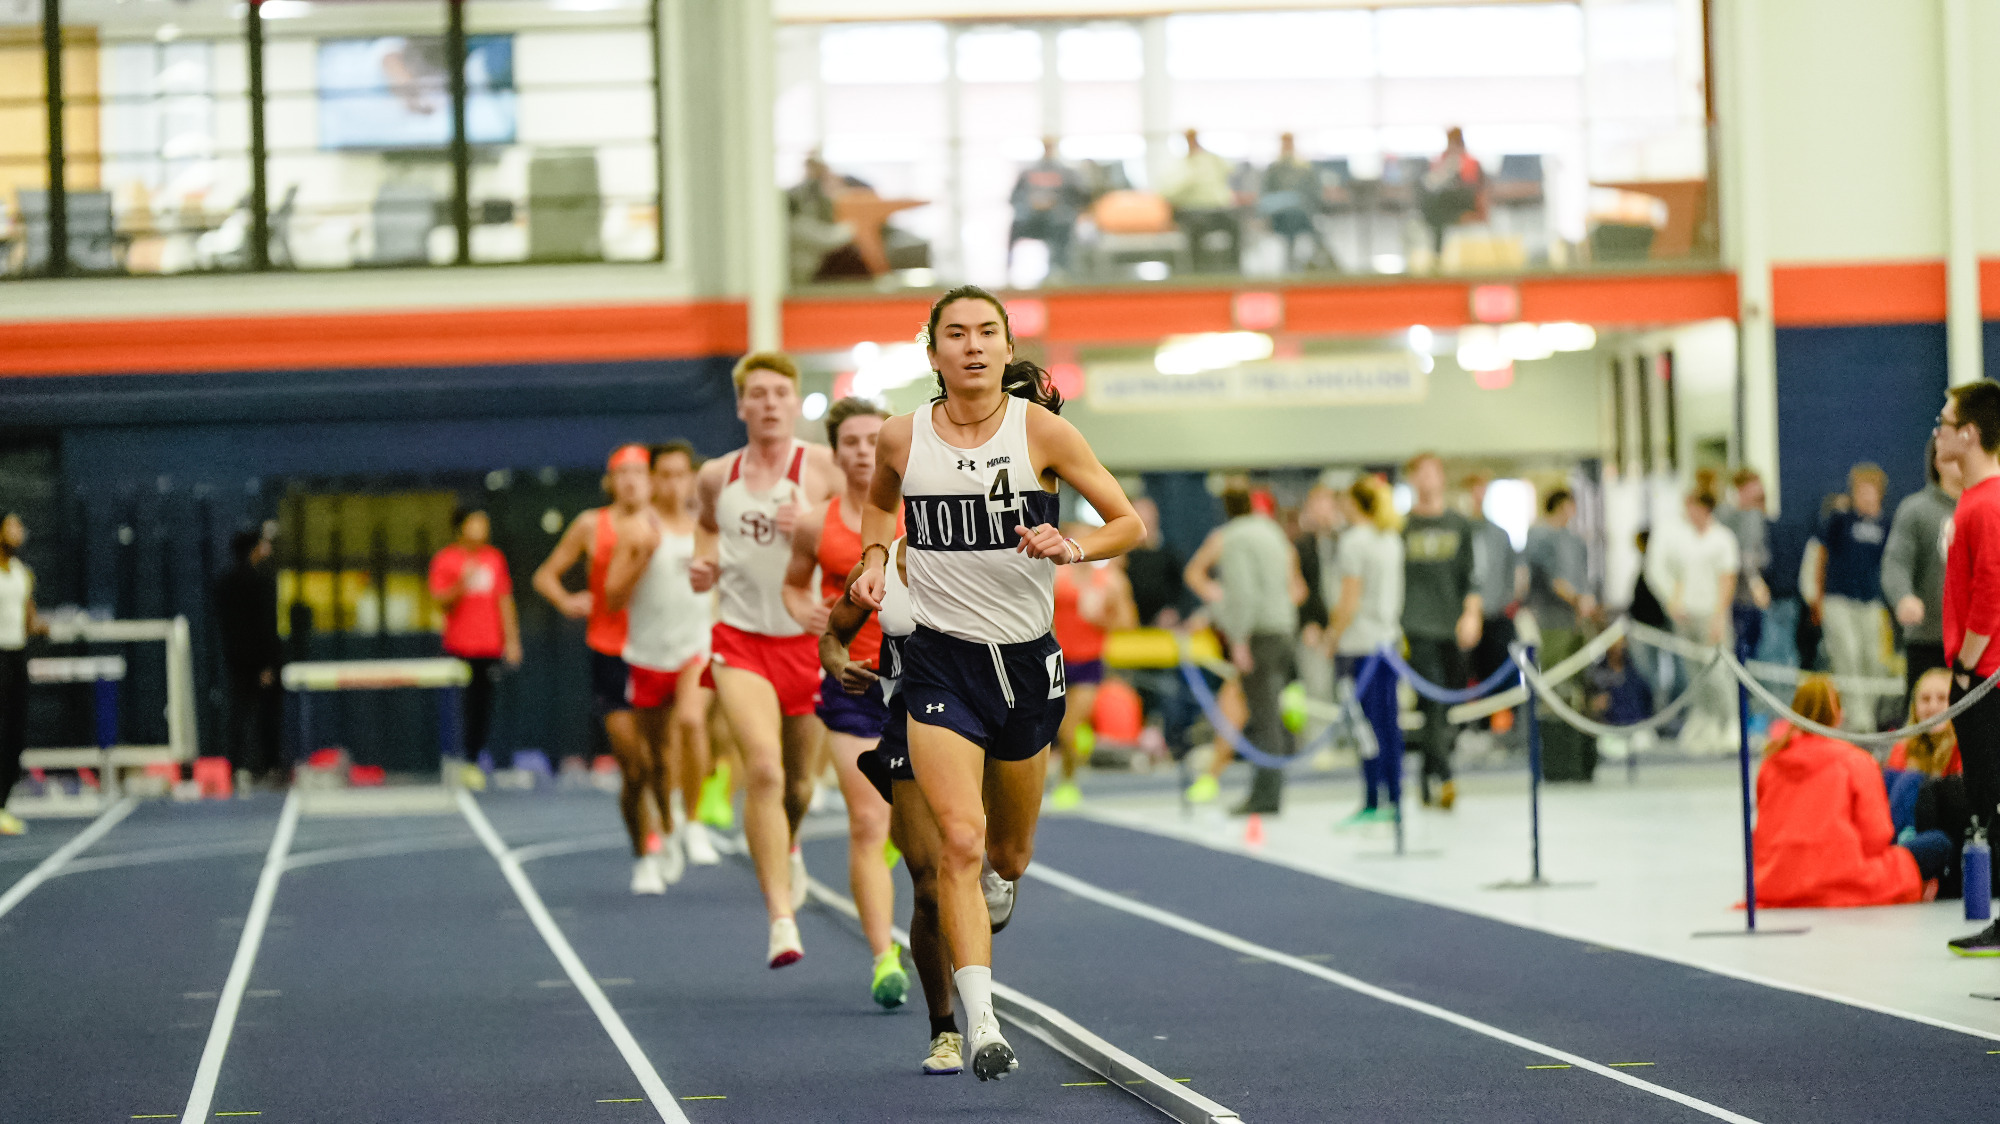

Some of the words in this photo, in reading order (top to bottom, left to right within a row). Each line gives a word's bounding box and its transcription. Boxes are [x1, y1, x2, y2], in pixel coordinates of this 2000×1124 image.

[986, 456, 1011, 468] MAAC
[988, 468, 1015, 509] 4
[911, 496, 1029, 546] MOUNT
[1052, 653, 1065, 693] 4
